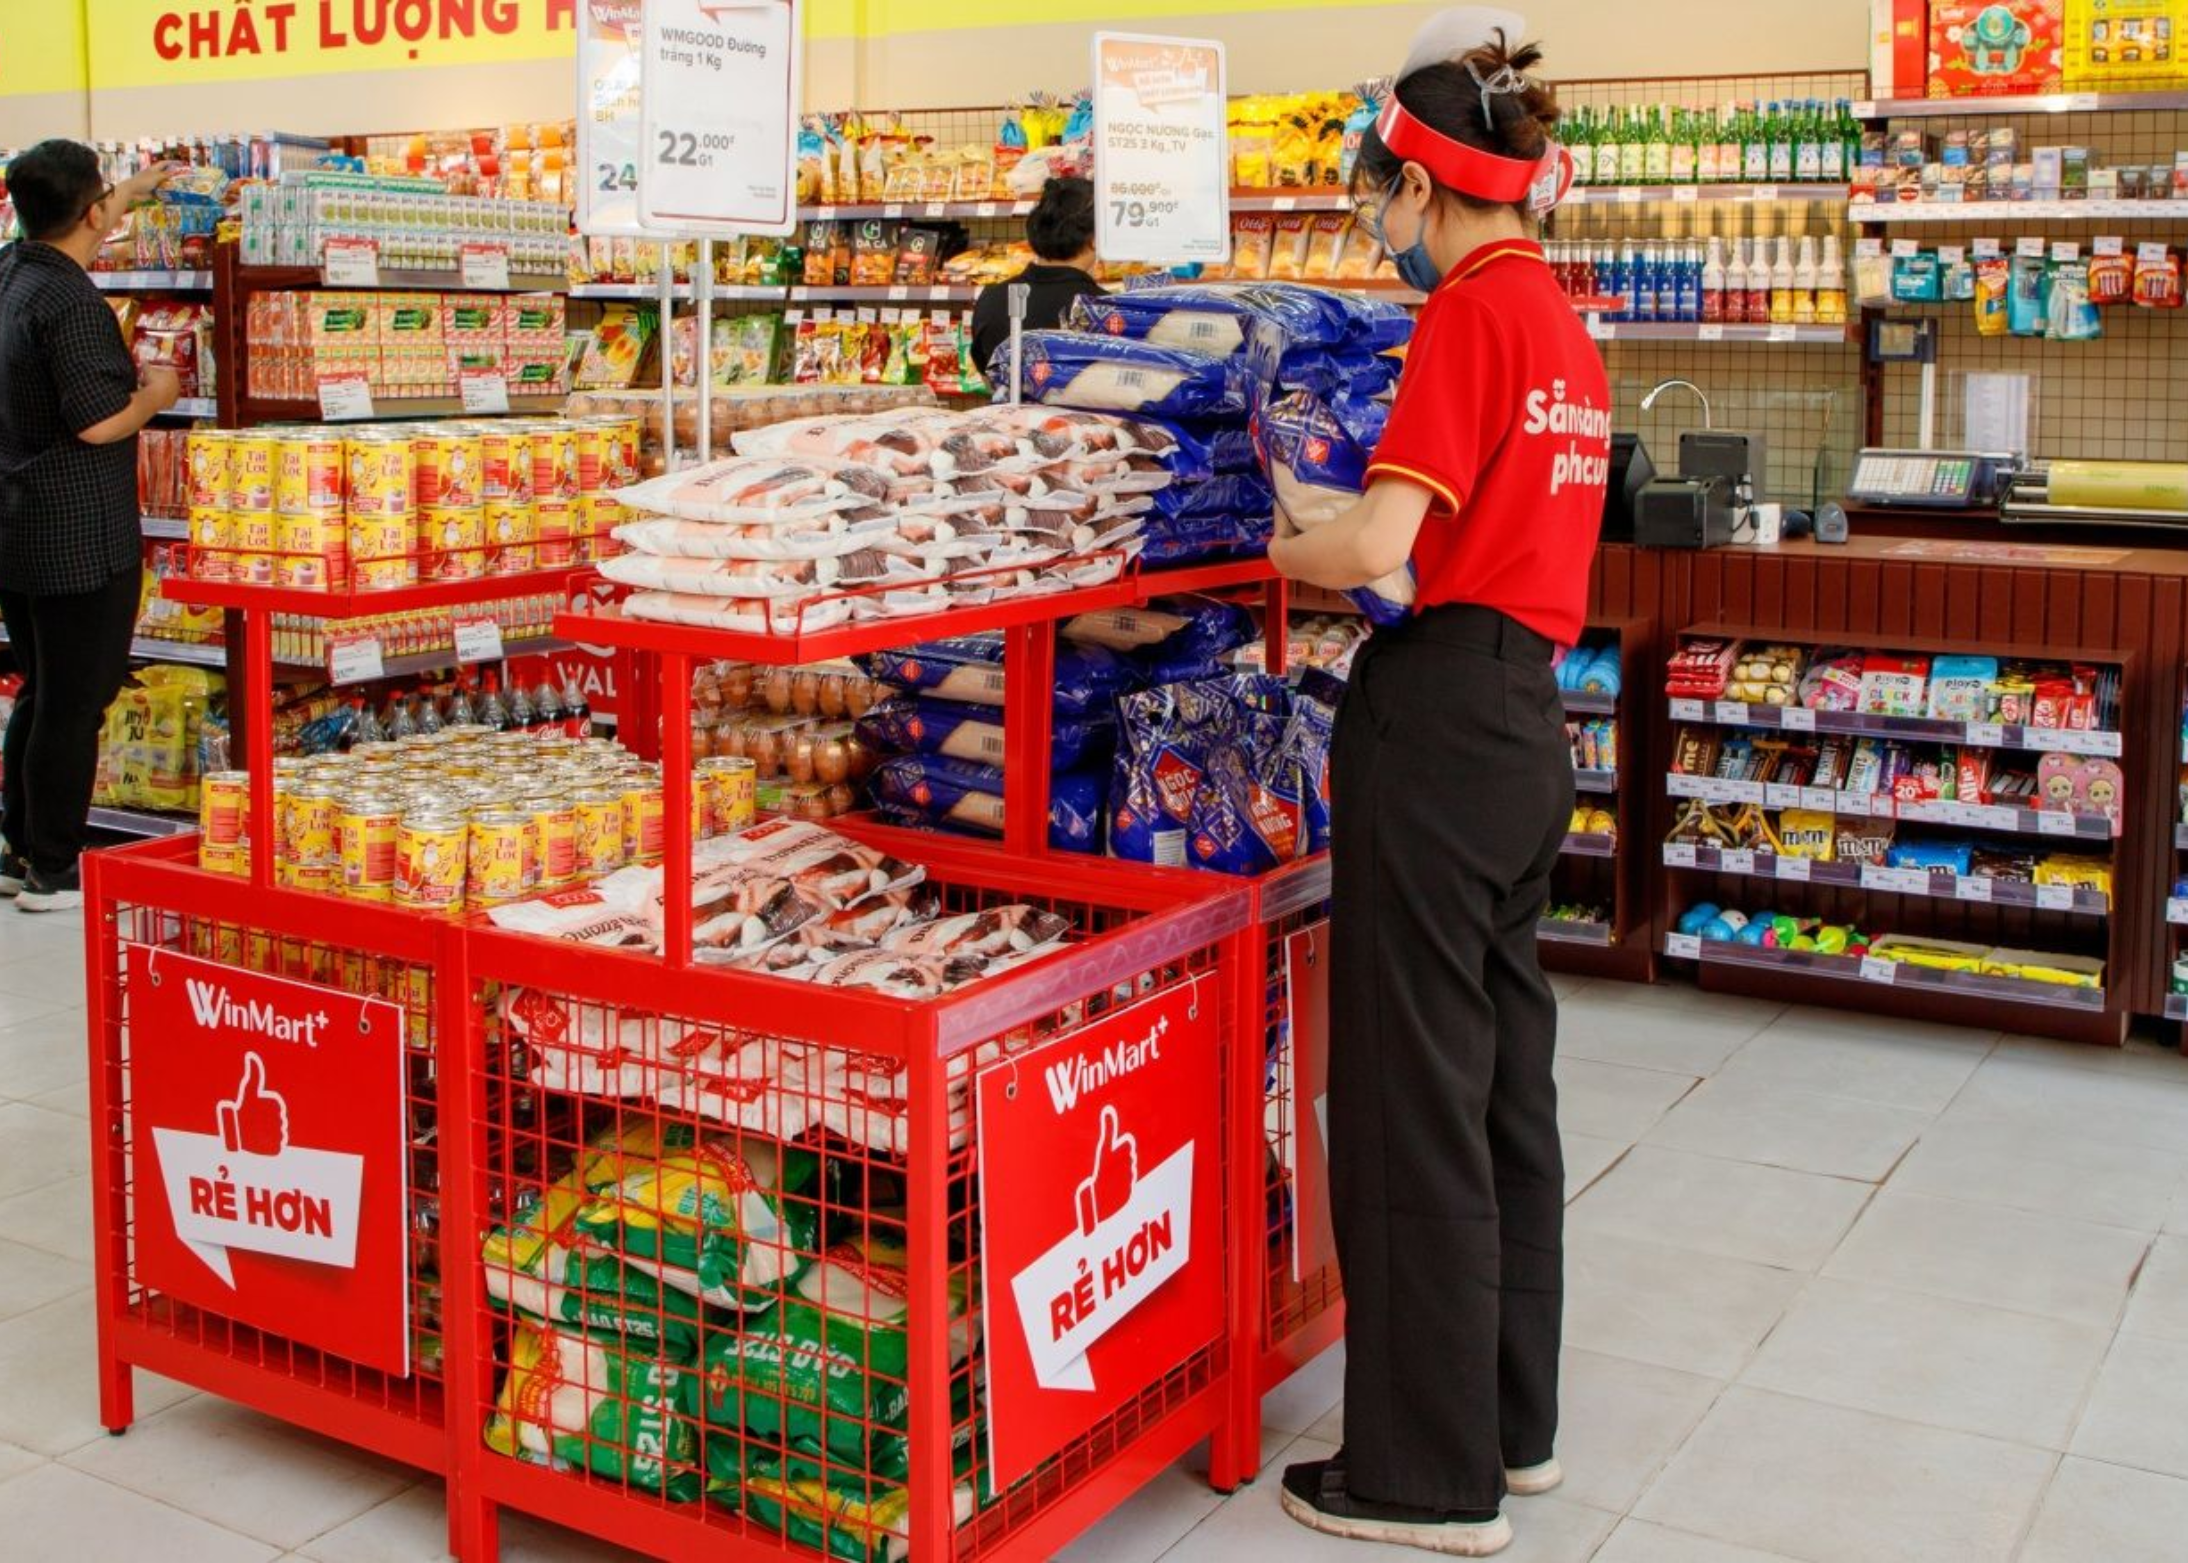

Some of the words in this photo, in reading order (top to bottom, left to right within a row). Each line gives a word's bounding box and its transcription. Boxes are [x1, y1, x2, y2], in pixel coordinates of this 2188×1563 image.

[661, 27, 724, 49] WMGOOD
[706, 53, 722, 71] Kg
[189, 1165, 238, 1222] RẺ
[245, 1186, 333, 1238] HƠN
[1050, 1257, 1096, 1341] RẺ
[1102, 1211, 1173, 1301] HƠN
